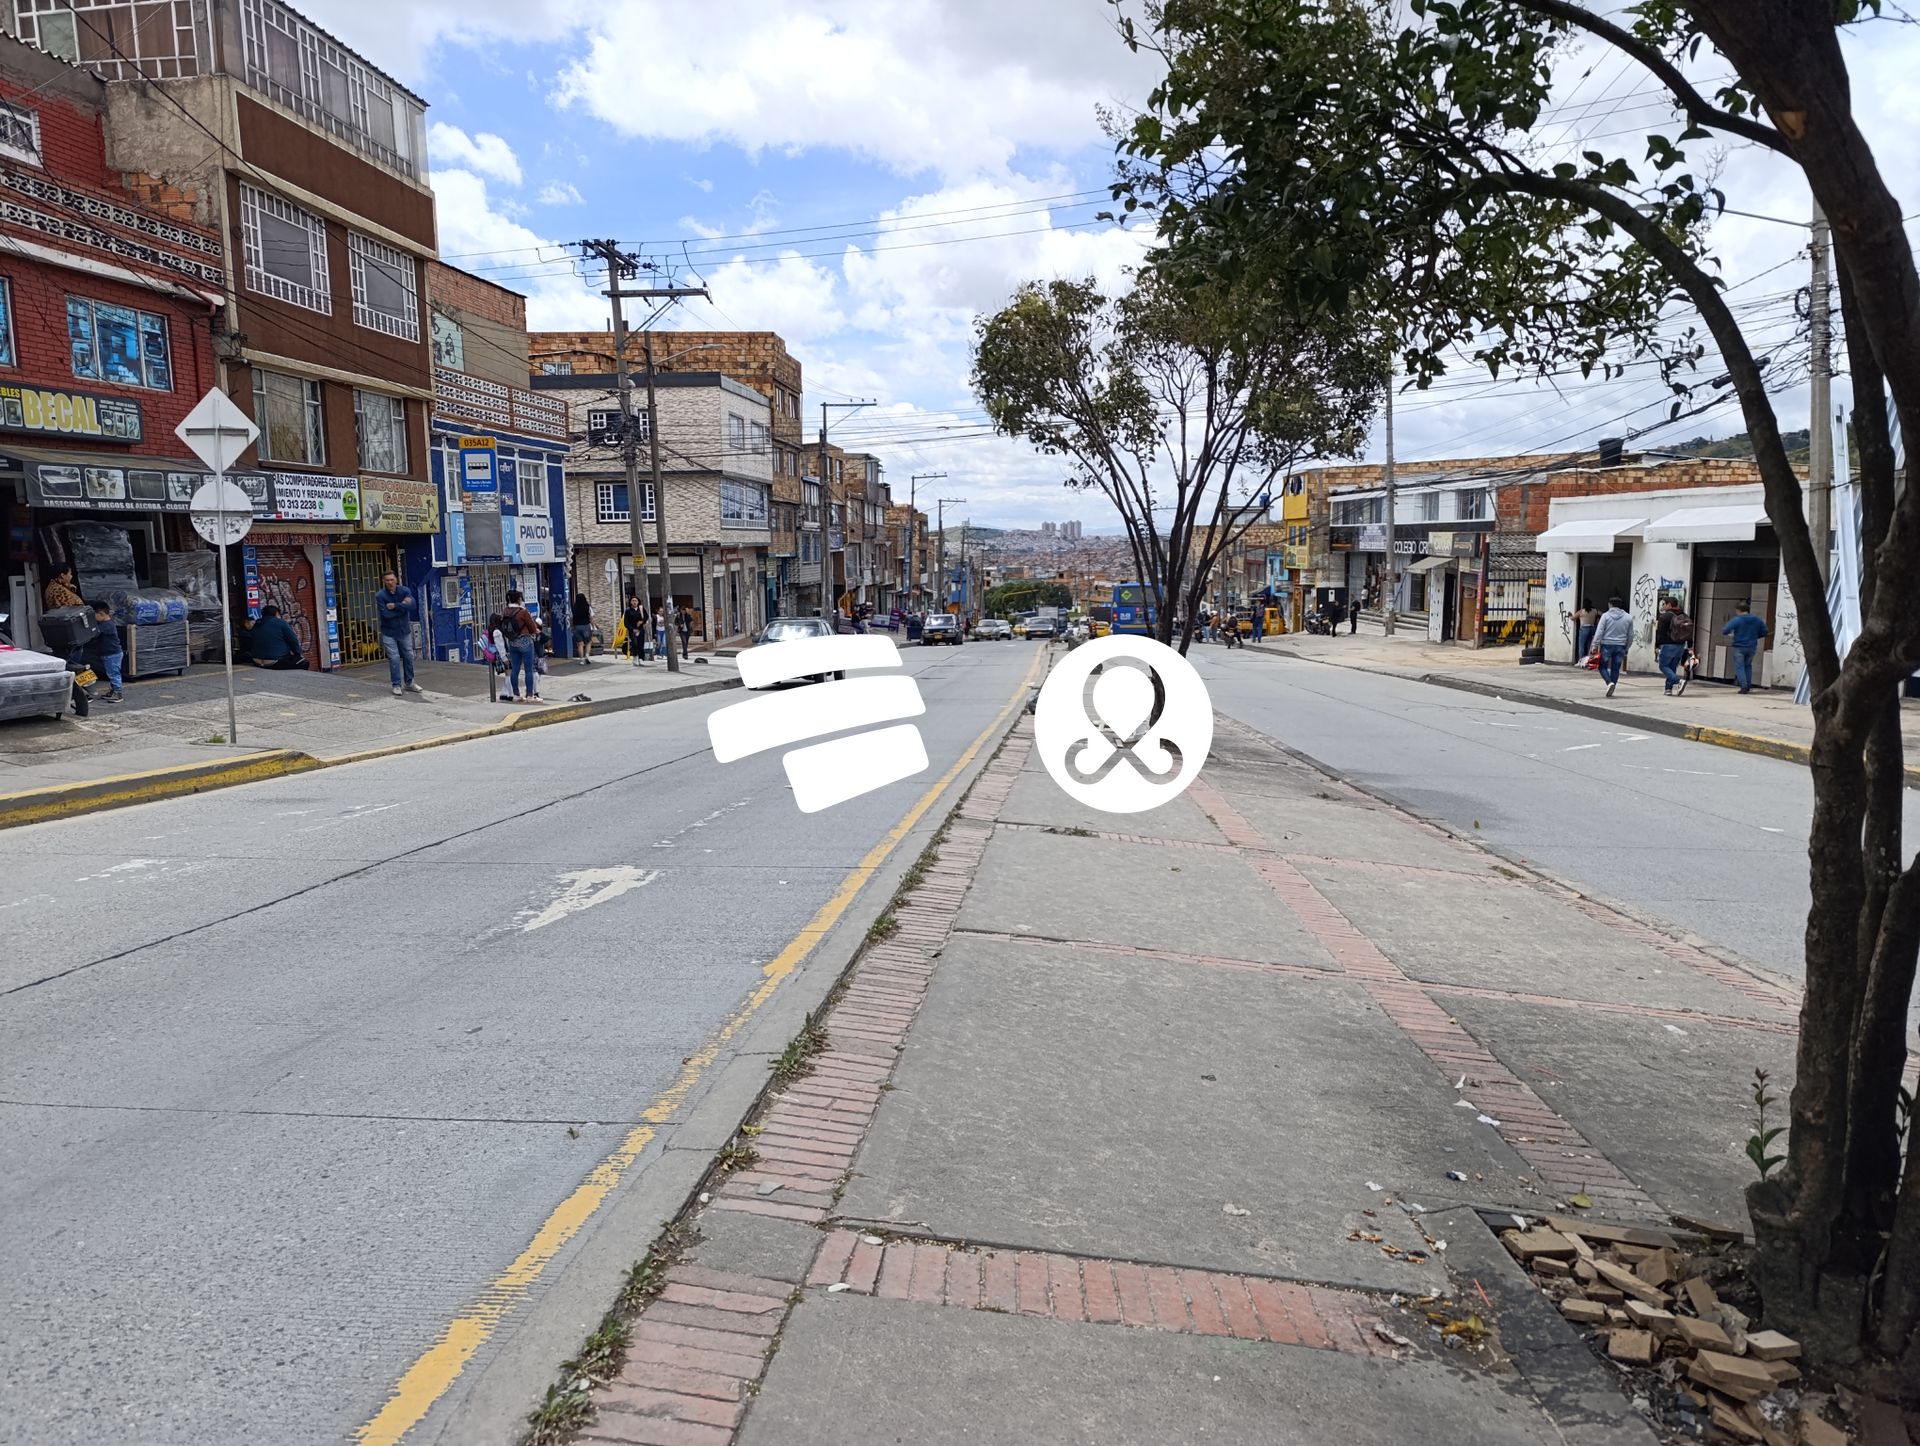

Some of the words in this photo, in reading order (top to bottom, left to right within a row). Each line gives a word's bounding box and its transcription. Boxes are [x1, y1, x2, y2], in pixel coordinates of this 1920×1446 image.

[0, 386, 20, 398] BLES
[21, 388, 102, 435] BECAL
[464, 439, 489, 447] 035A12
[284, 474, 329, 488] COMPUTADORES
[329, 478, 357, 489] CELULARES
[362, 477, 437, 496] EMBOBINADOS
[302, 489, 306, 499] Y
[307, 489, 342, 500] REPARACIÓN
[44, 499, 91, 508] BASECAMAS
[98, 501, 124, 509] JUEGOS
[287, 500, 299, 509] 313
[300, 500, 317, 510] 2238
[243, 533, 288, 545] SERVICIO
[1394, 541, 1416, 554] COLEGIO
